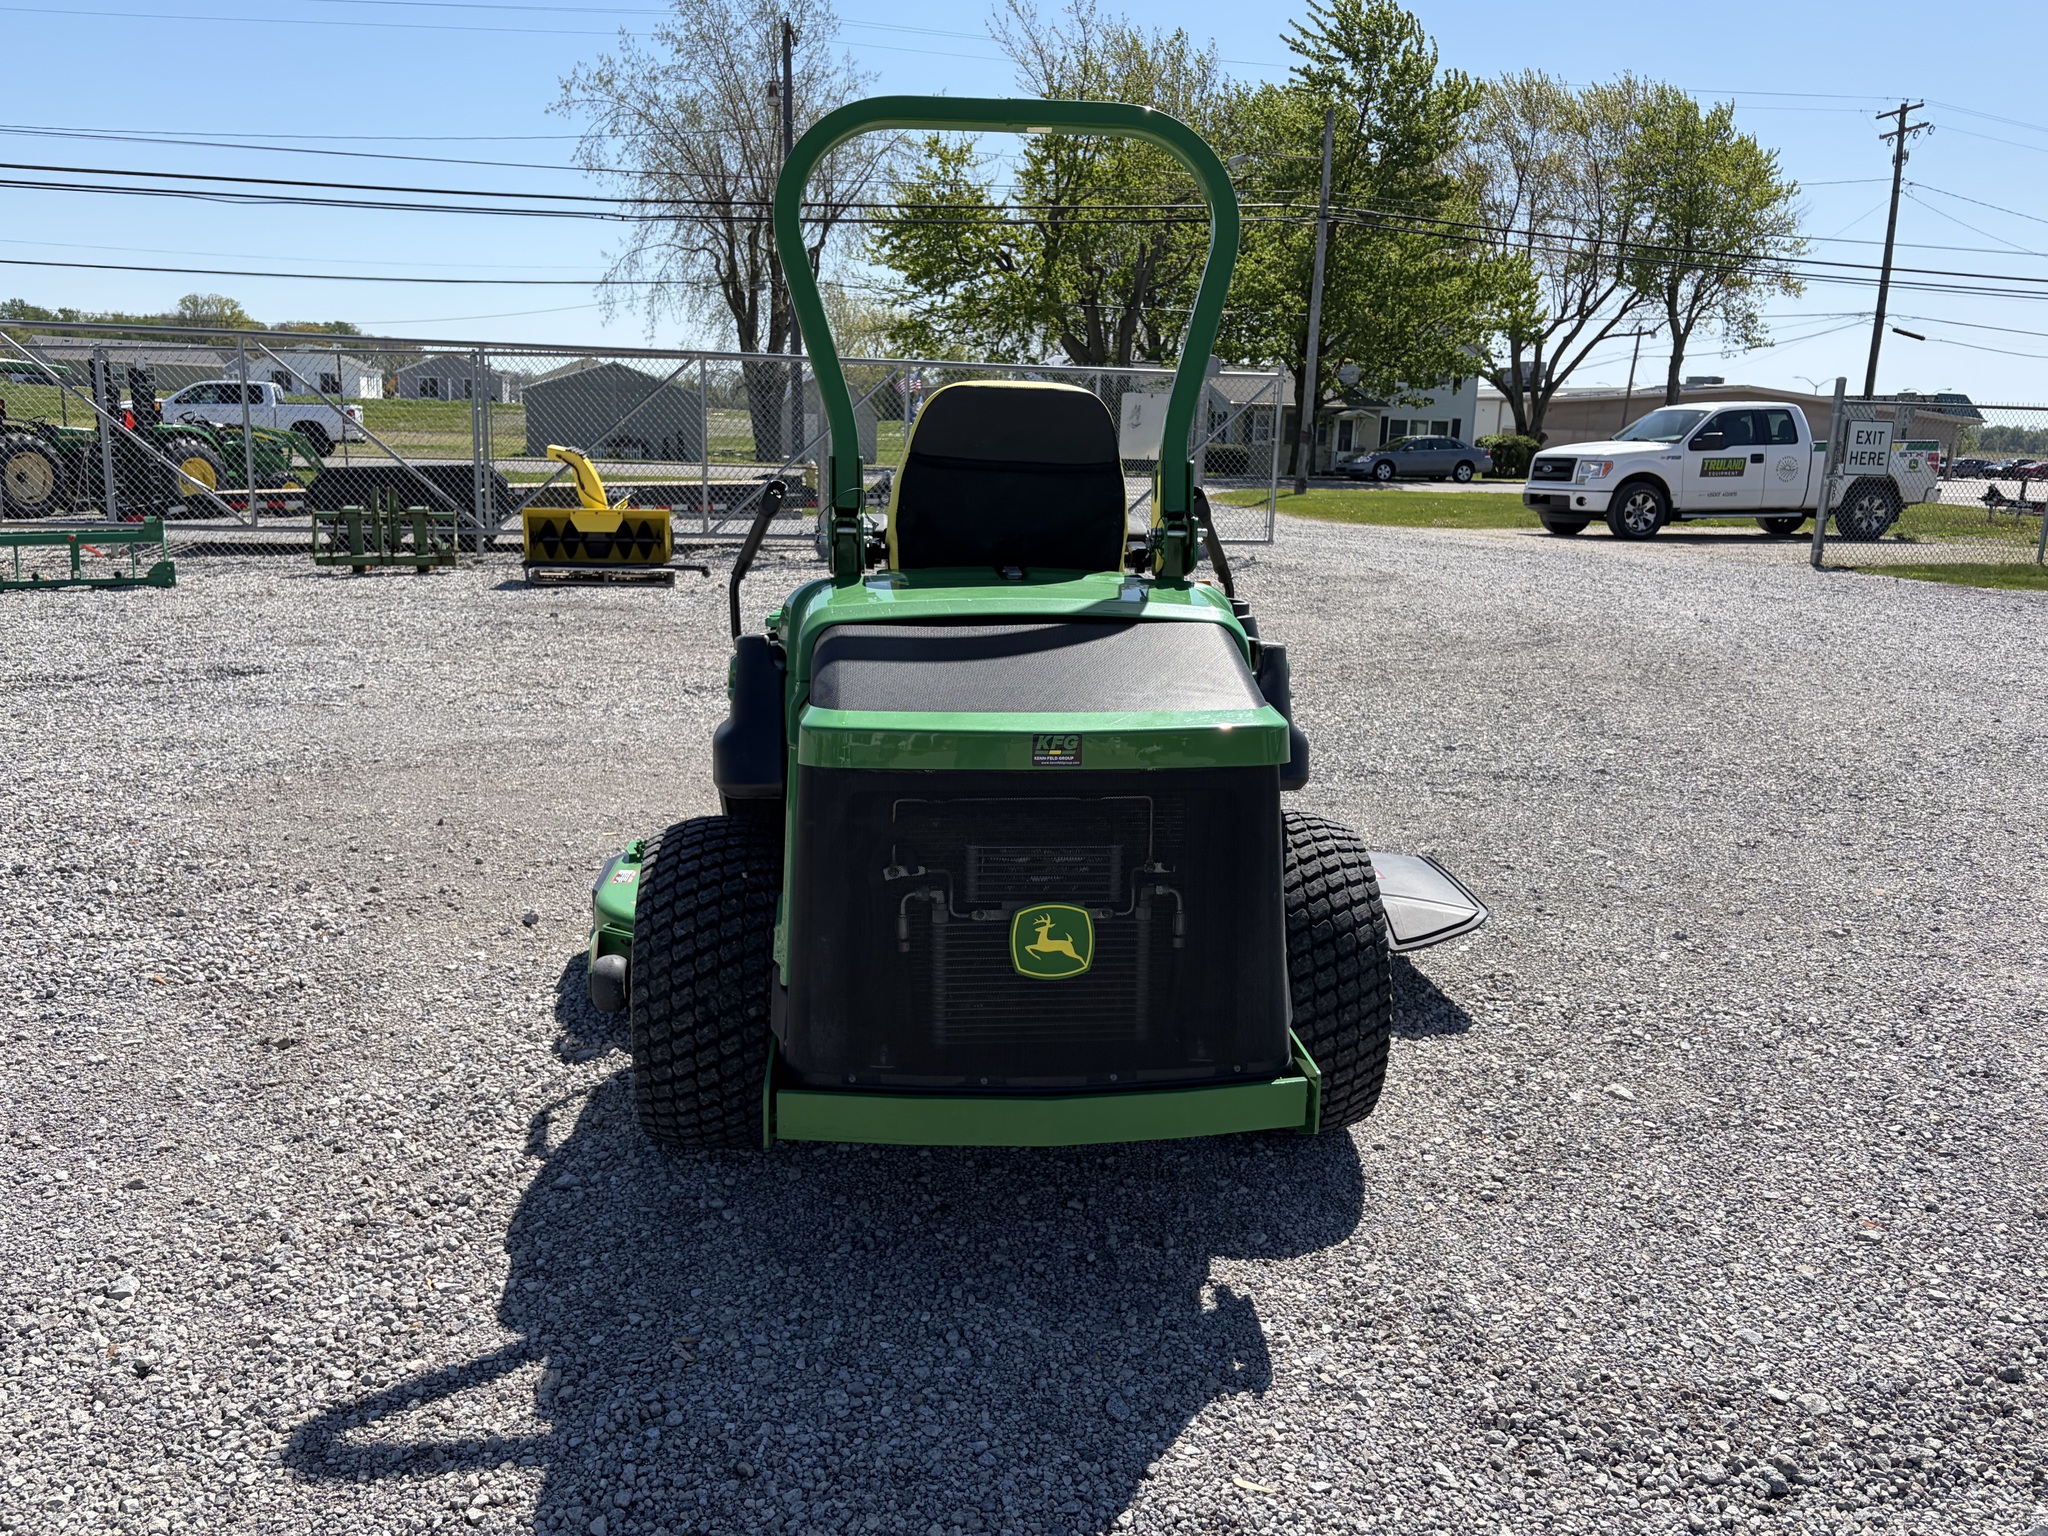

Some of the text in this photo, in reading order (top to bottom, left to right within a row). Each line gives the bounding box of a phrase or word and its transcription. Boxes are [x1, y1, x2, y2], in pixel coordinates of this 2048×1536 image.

[1856, 430, 1885, 445] EXIT
[1703, 459, 1745, 471] TRULAND
[1849, 451, 1886, 466] HERE
[1036, 735, 1079, 750] KFG
